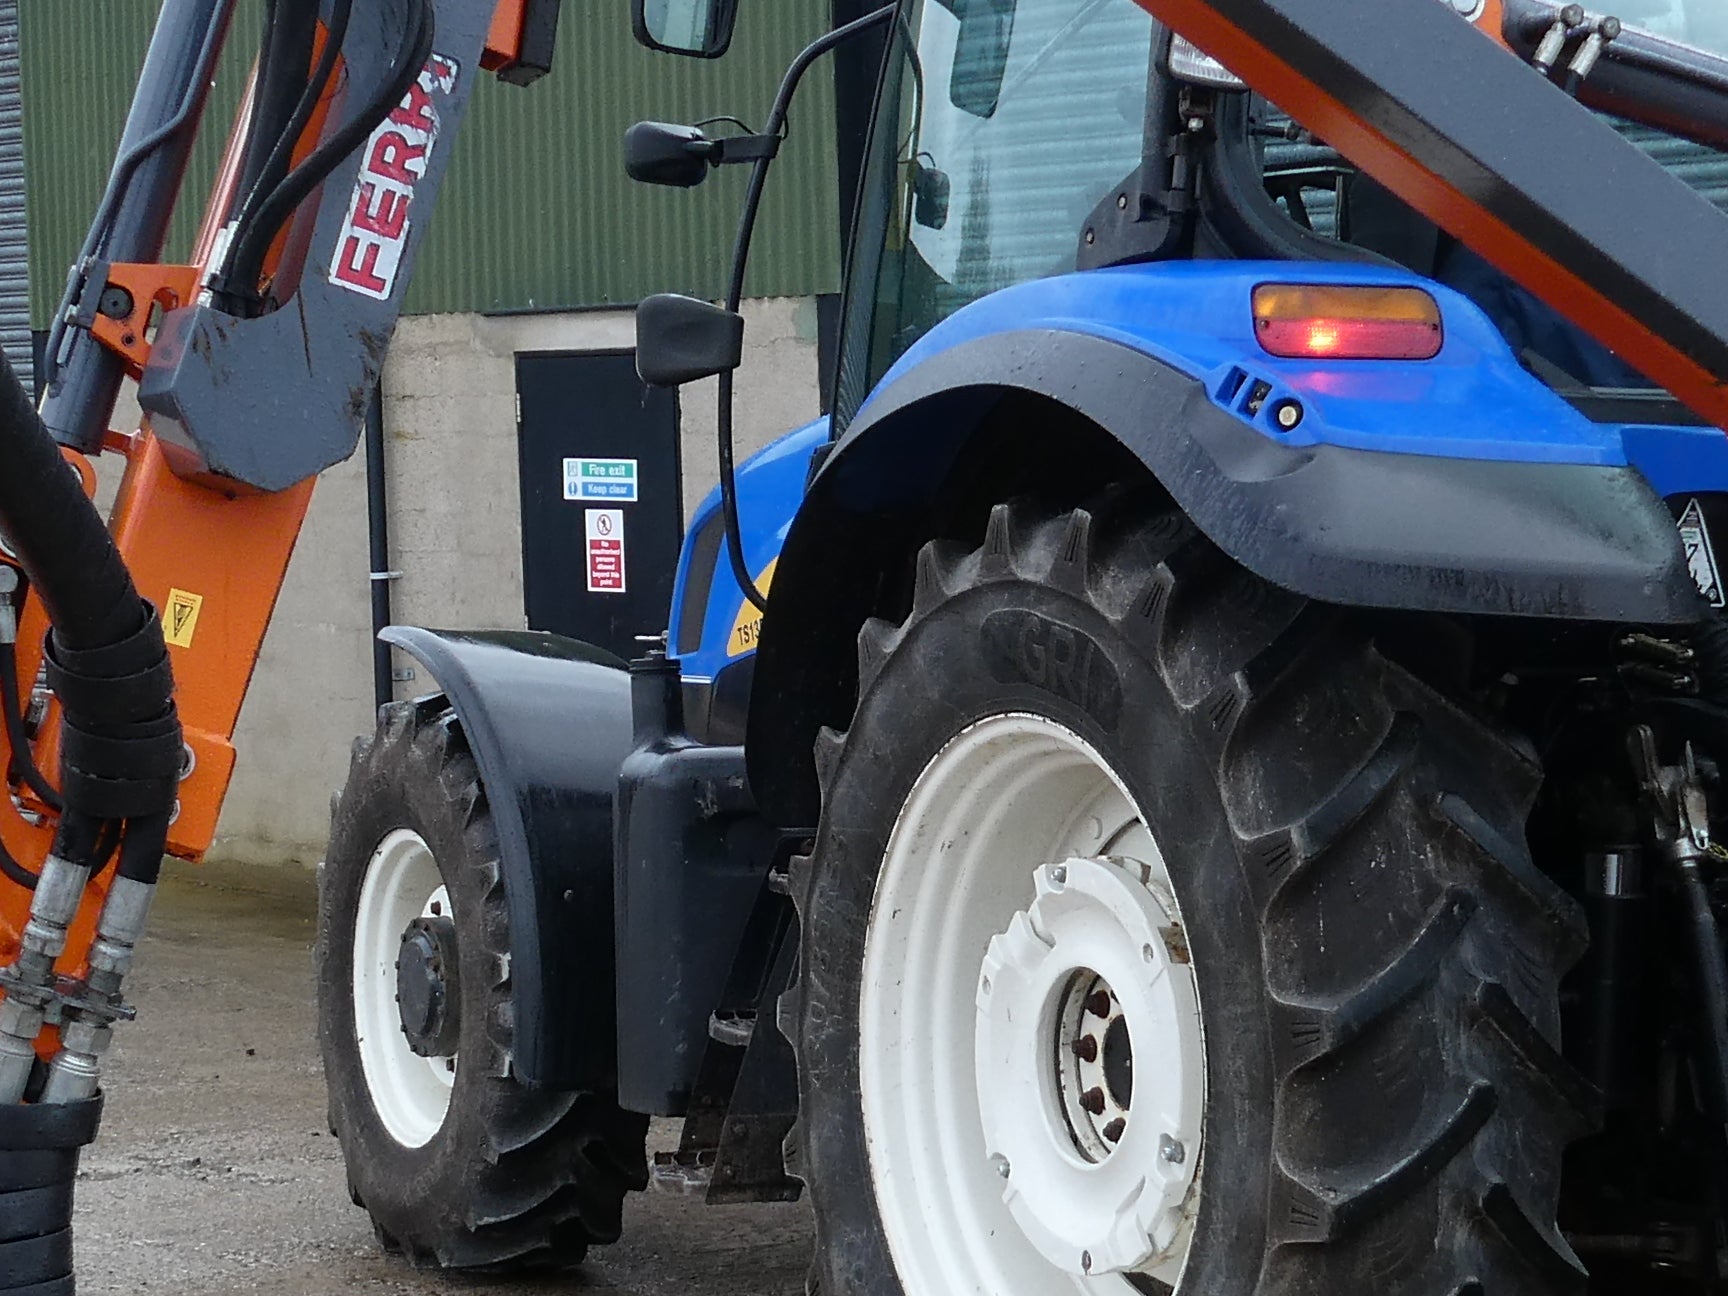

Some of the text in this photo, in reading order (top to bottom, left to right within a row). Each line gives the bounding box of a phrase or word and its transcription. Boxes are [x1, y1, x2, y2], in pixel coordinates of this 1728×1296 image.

[588, 464, 626, 476] Fire exit
[587, 484, 607, 495] Keep
[737, 618, 762, 646] TS13
